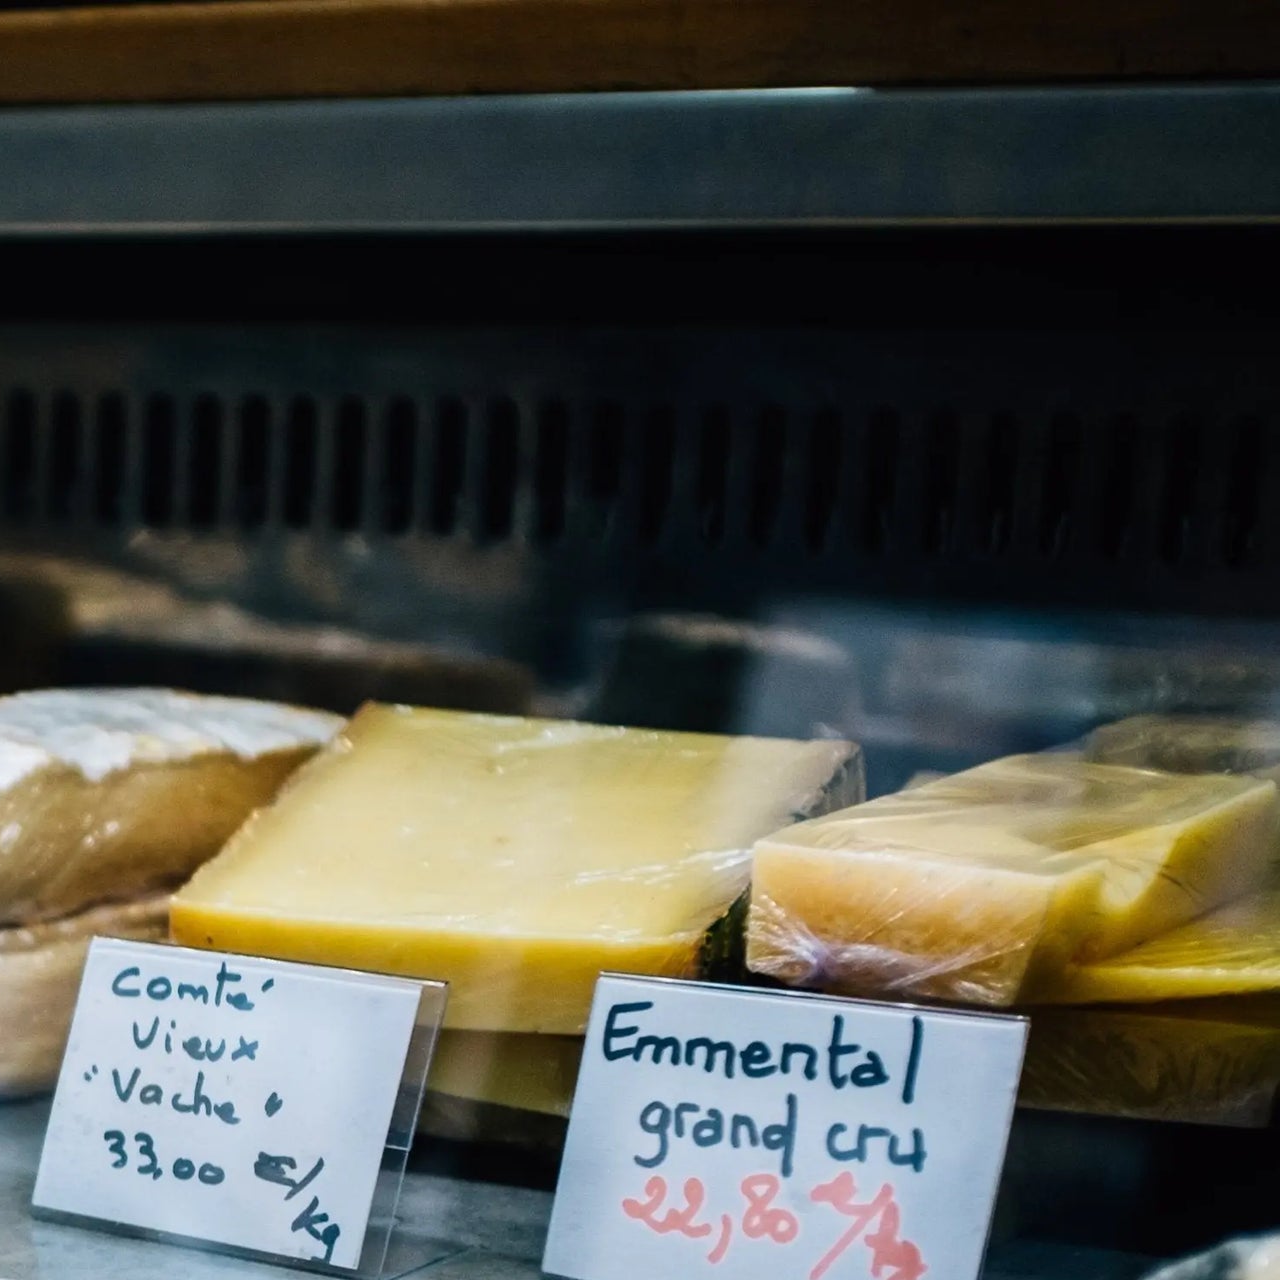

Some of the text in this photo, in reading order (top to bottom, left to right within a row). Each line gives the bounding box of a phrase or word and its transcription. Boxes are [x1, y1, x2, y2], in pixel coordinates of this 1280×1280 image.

[132, 1016, 260, 1062] Vieux
[601, 1001, 925, 1105] Emmental
[633, 1092, 928, 1178] grand cru
[621, 1172, 800, 1265] 22,80
